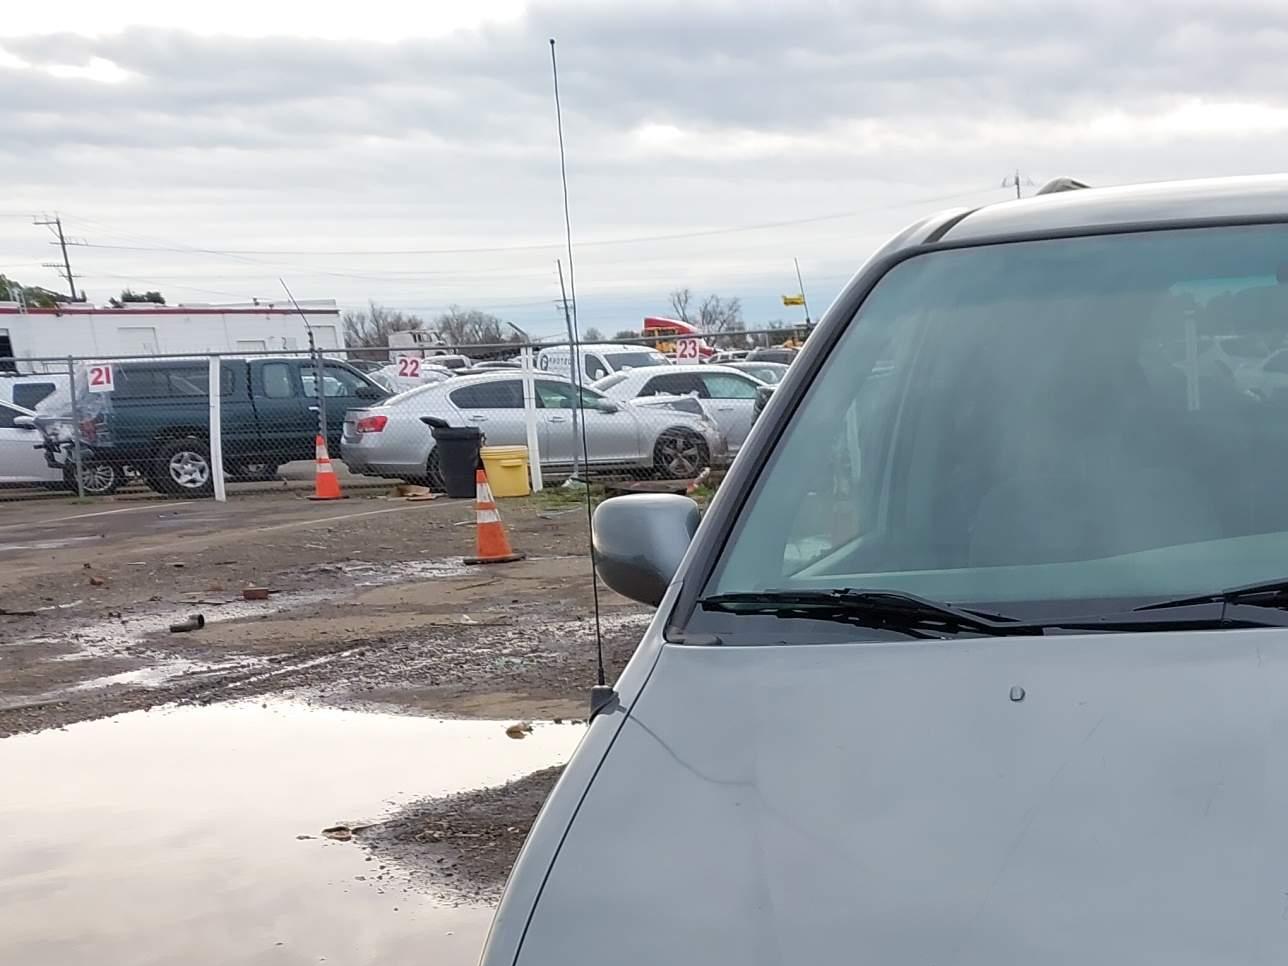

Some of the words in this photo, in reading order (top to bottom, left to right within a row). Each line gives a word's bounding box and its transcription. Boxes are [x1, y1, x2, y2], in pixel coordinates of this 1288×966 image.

[679, 340, 698, 359] 23
[90, 366, 111, 385] 21
[399, 358, 420, 377] 22
